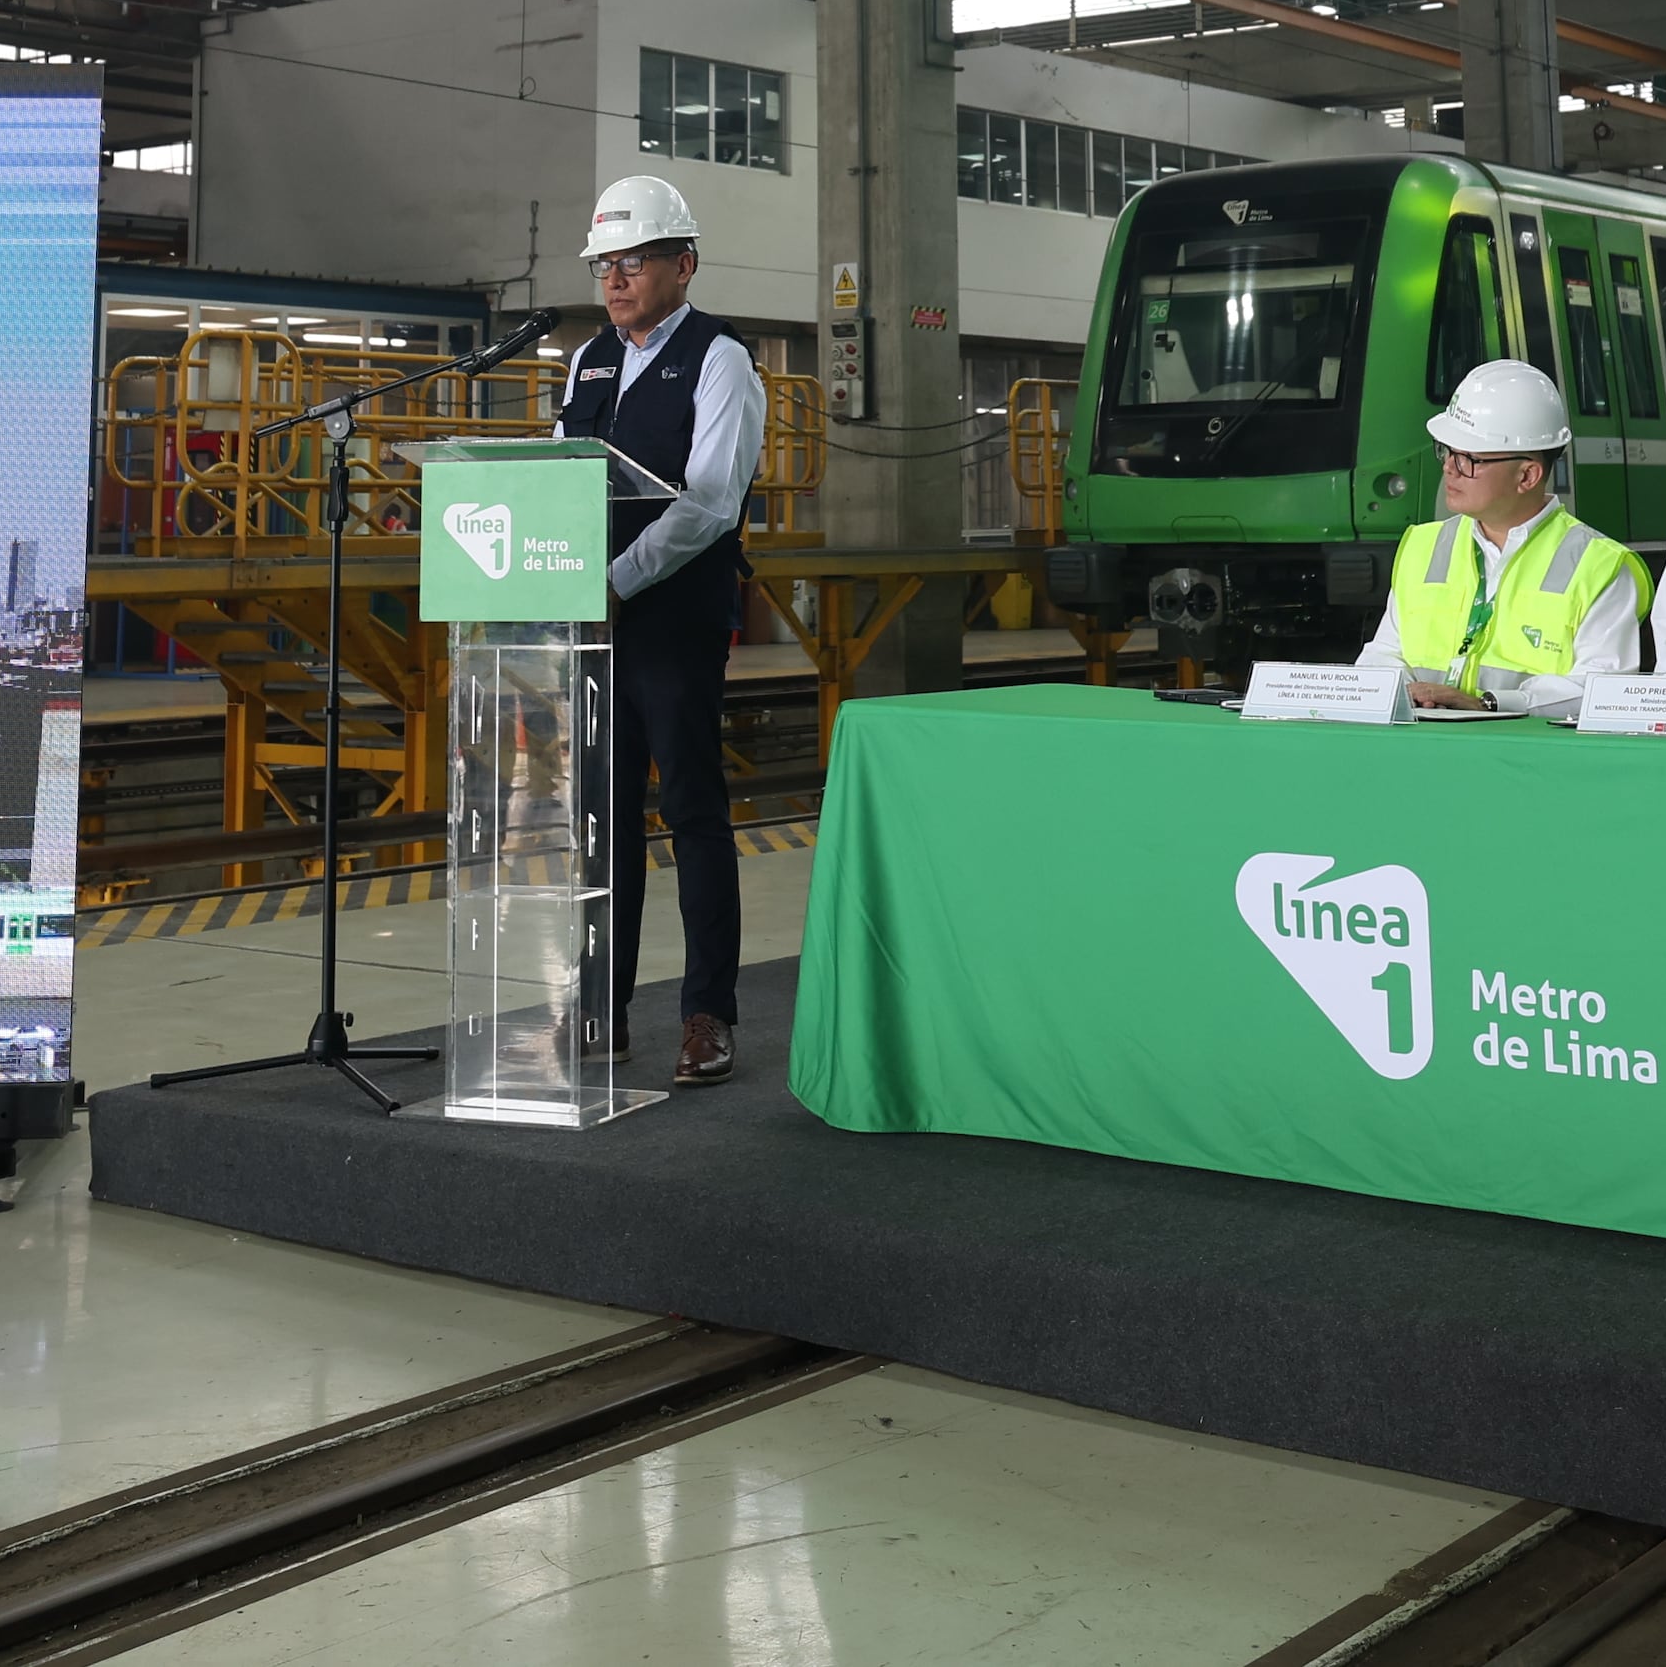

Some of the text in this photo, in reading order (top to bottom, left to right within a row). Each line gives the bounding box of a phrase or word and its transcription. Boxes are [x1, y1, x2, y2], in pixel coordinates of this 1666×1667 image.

[1149, 304, 1168, 319] 26
[456, 514, 504, 533] línea
[523, 537, 568, 552] Metro
[490, 538, 504, 570] 1
[523, 555, 584, 571] de Lima
[1289, 672, 1359, 682] MANUEL WU ROCHA
[1277, 690, 1295, 699] LÍNEA
[1623, 686, 1646, 695] ALDO
[1272, 882, 1410, 947] línea
[1470, 969, 1607, 1024] Metro
[1371, 961, 1414, 1055] 1
[1471, 1022, 1659, 1085] de Lima
